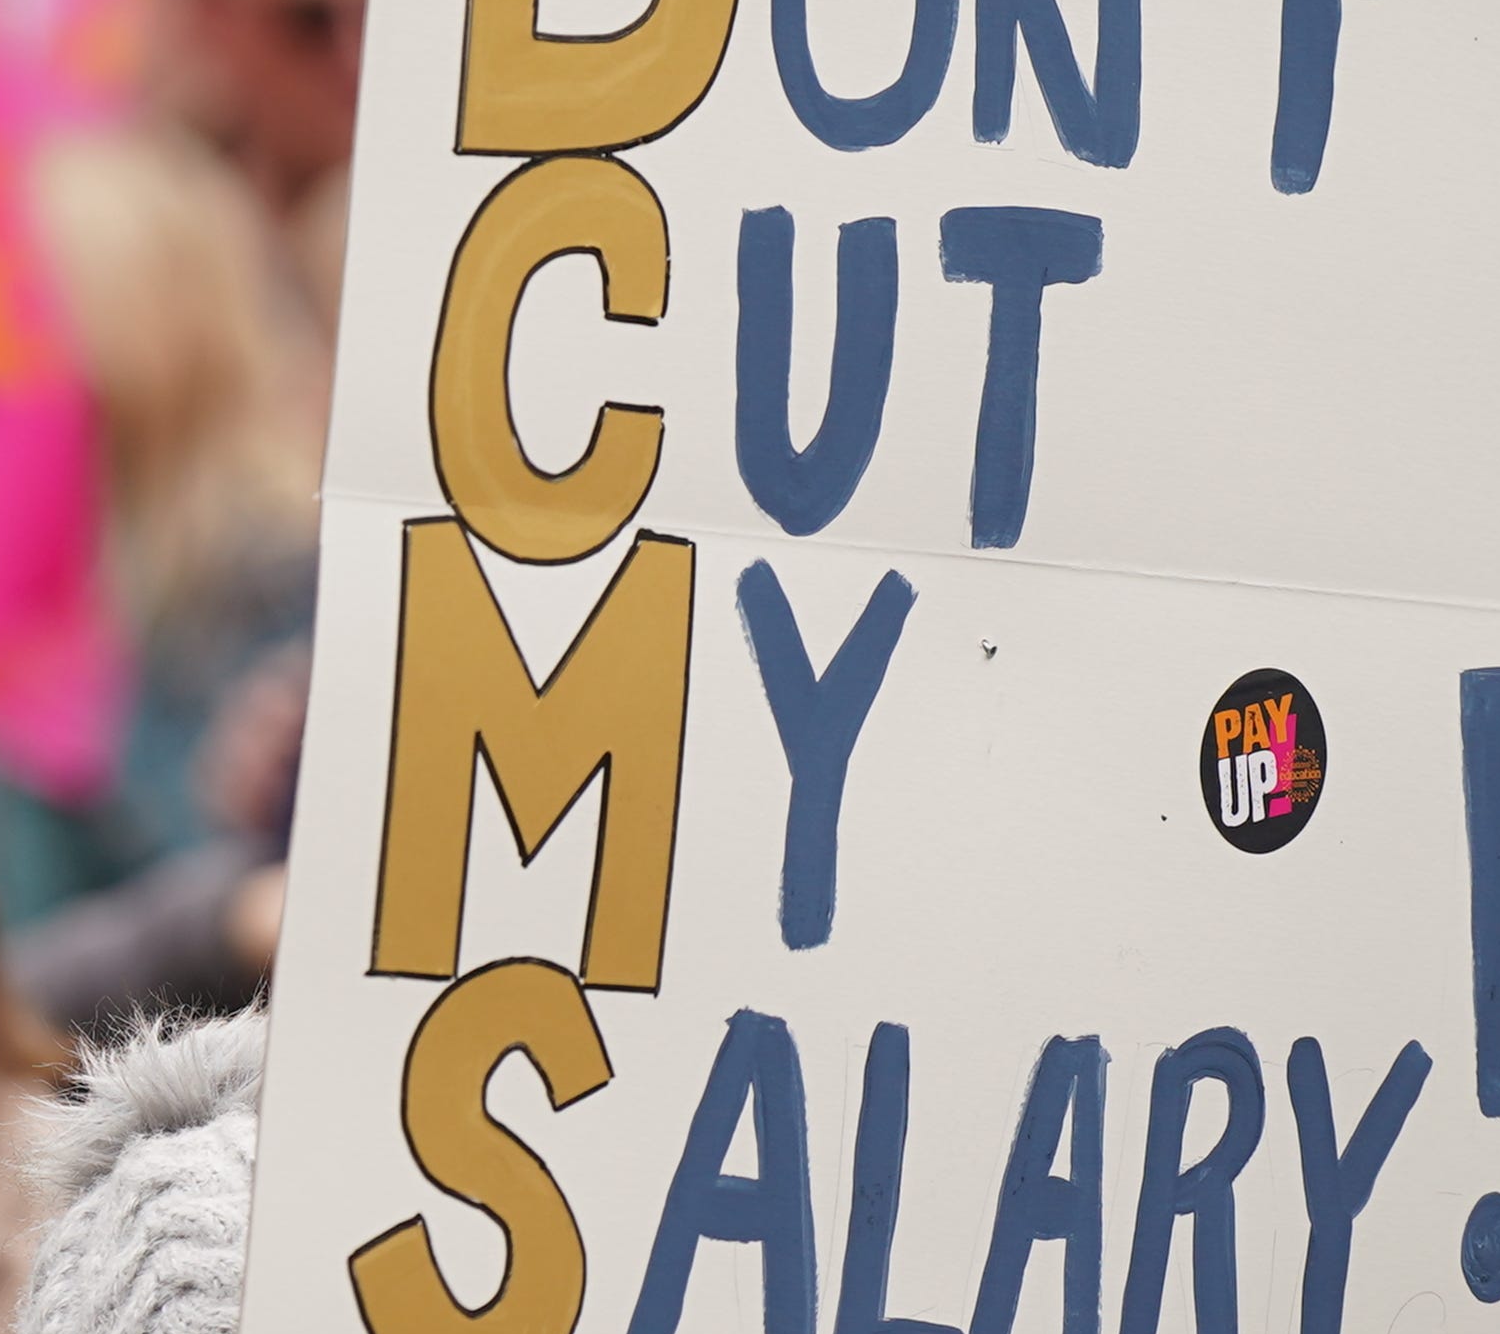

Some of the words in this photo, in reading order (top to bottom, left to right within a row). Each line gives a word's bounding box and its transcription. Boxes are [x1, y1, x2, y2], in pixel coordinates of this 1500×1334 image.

[427, 152, 1103, 565] CUT
[364, 515, 918, 995] MY
[1214, 693, 1293, 759] PAY
